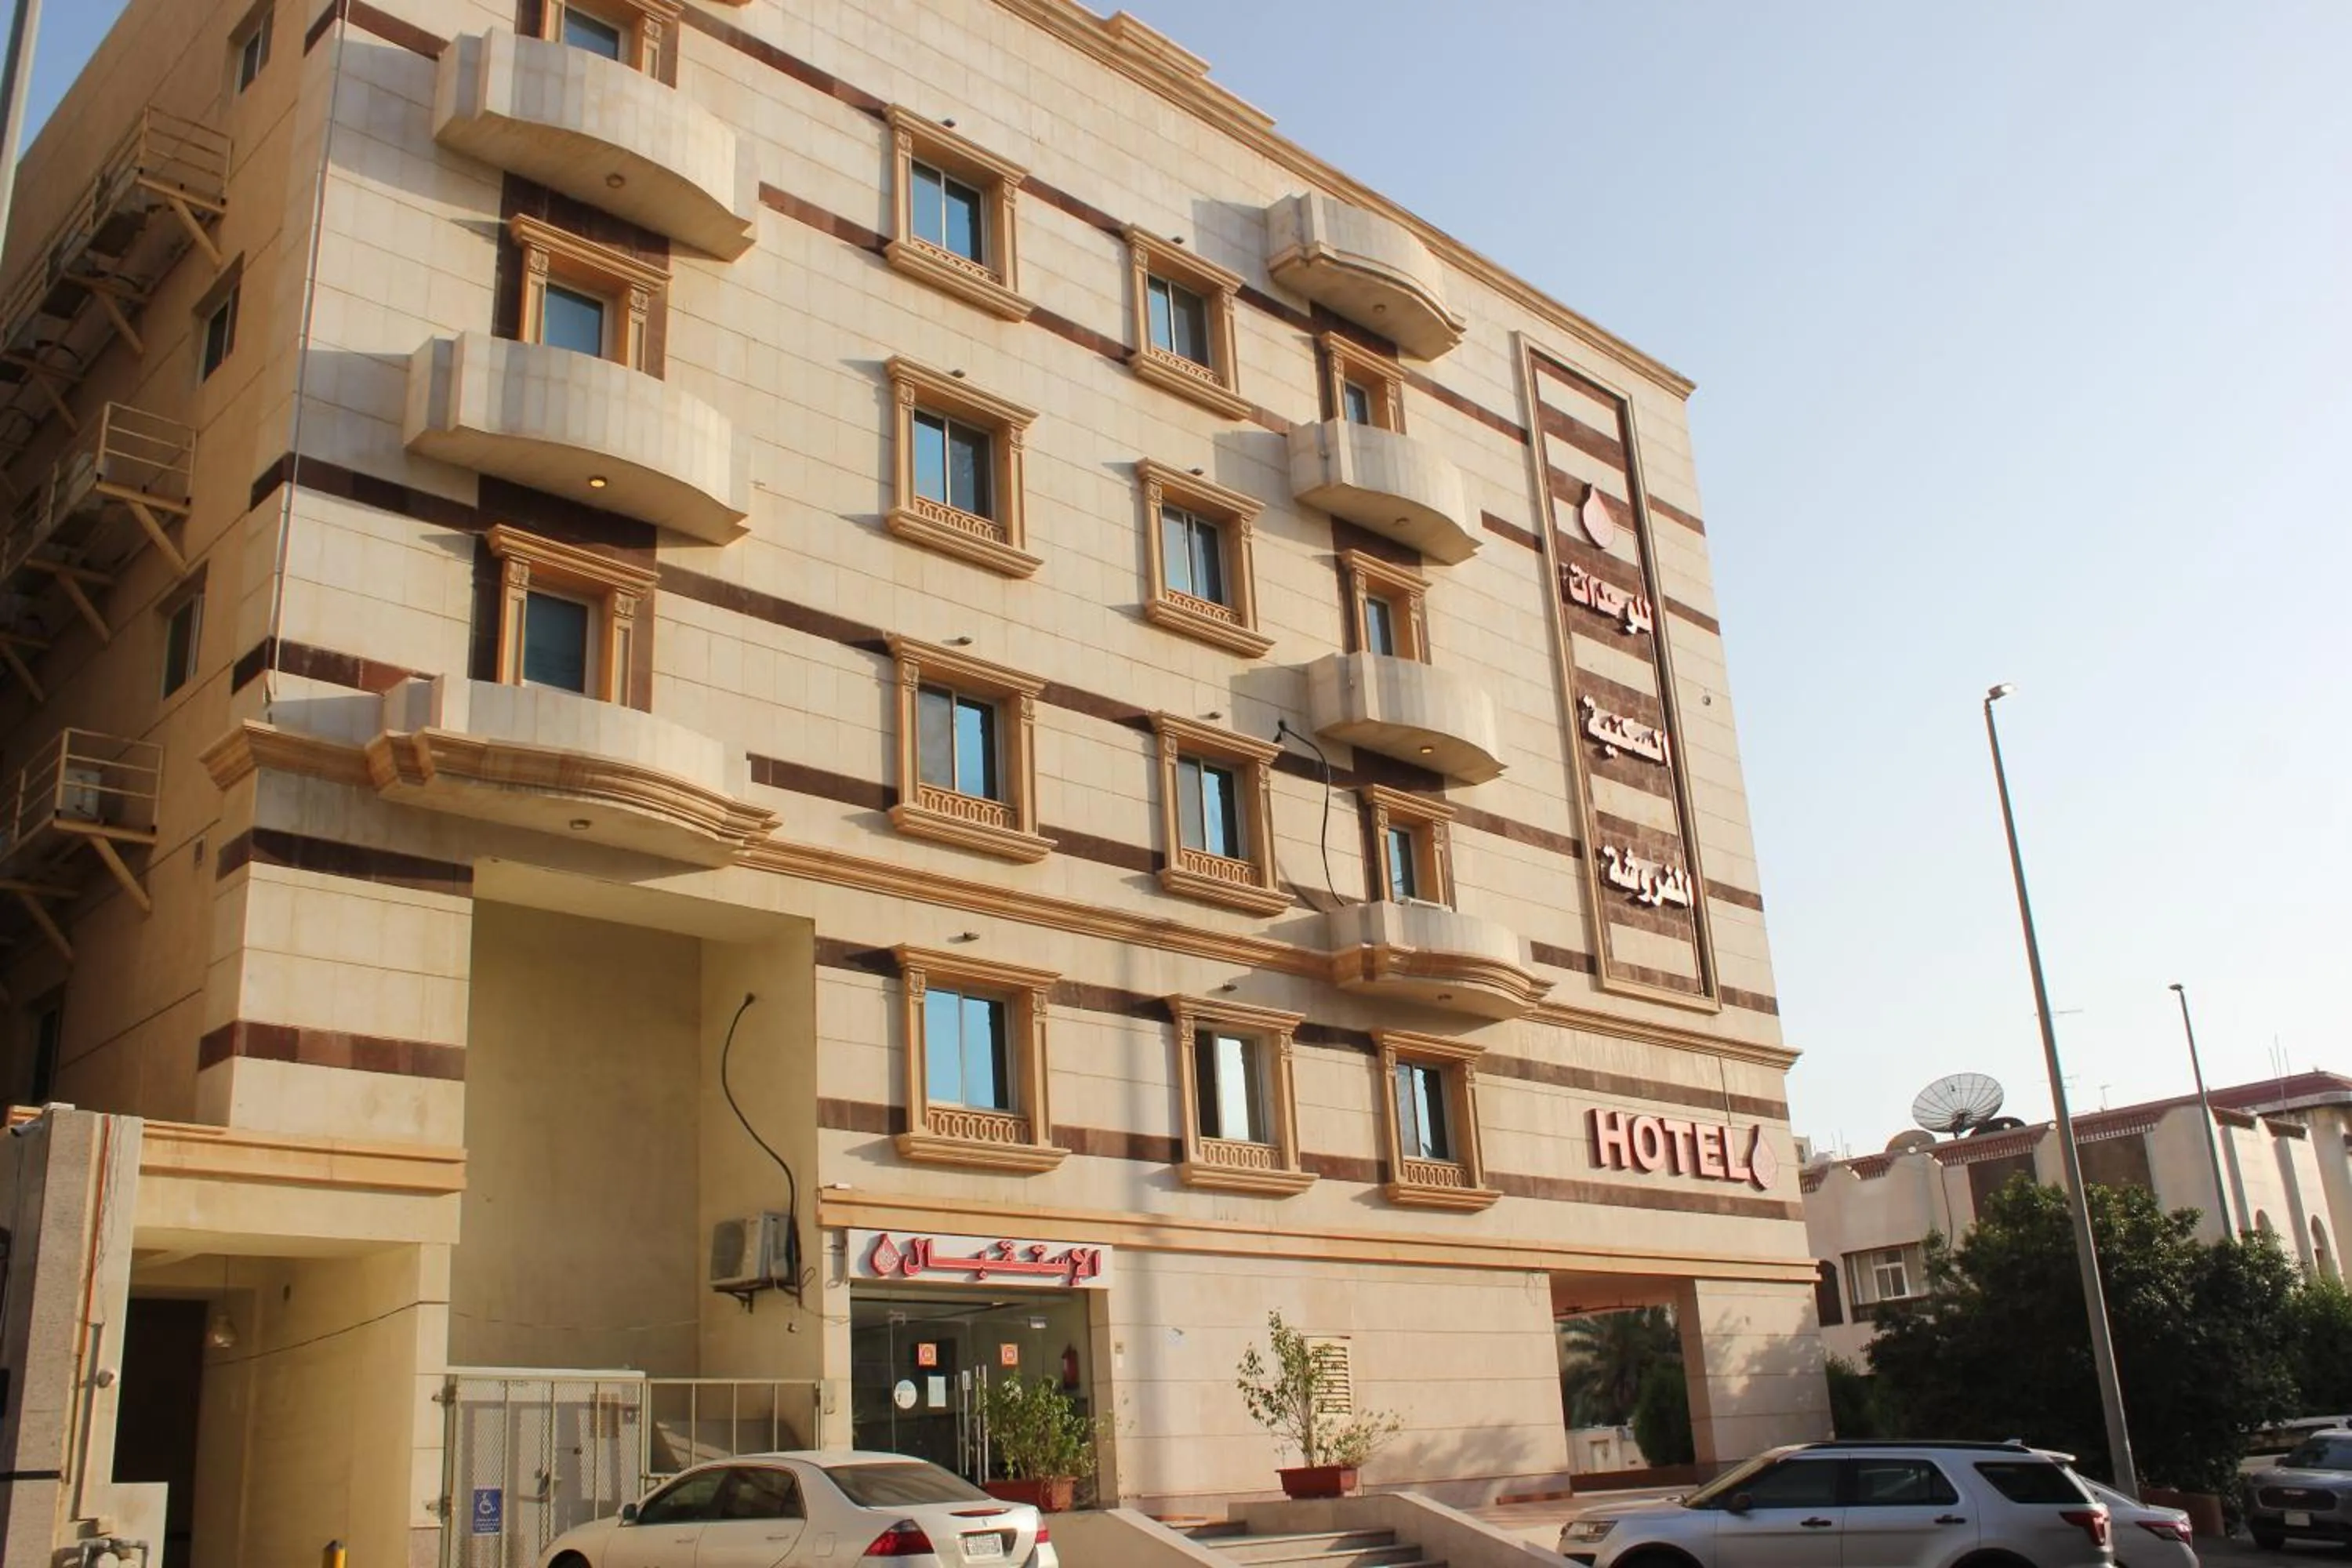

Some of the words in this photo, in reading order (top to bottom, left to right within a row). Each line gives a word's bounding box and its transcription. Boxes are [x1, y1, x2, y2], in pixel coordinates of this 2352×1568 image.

[1582, 695, 1672, 768] السكنية
[1602, 845, 1693, 908] المفروشة
[1592, 1109, 1751, 1182] HOTEL
